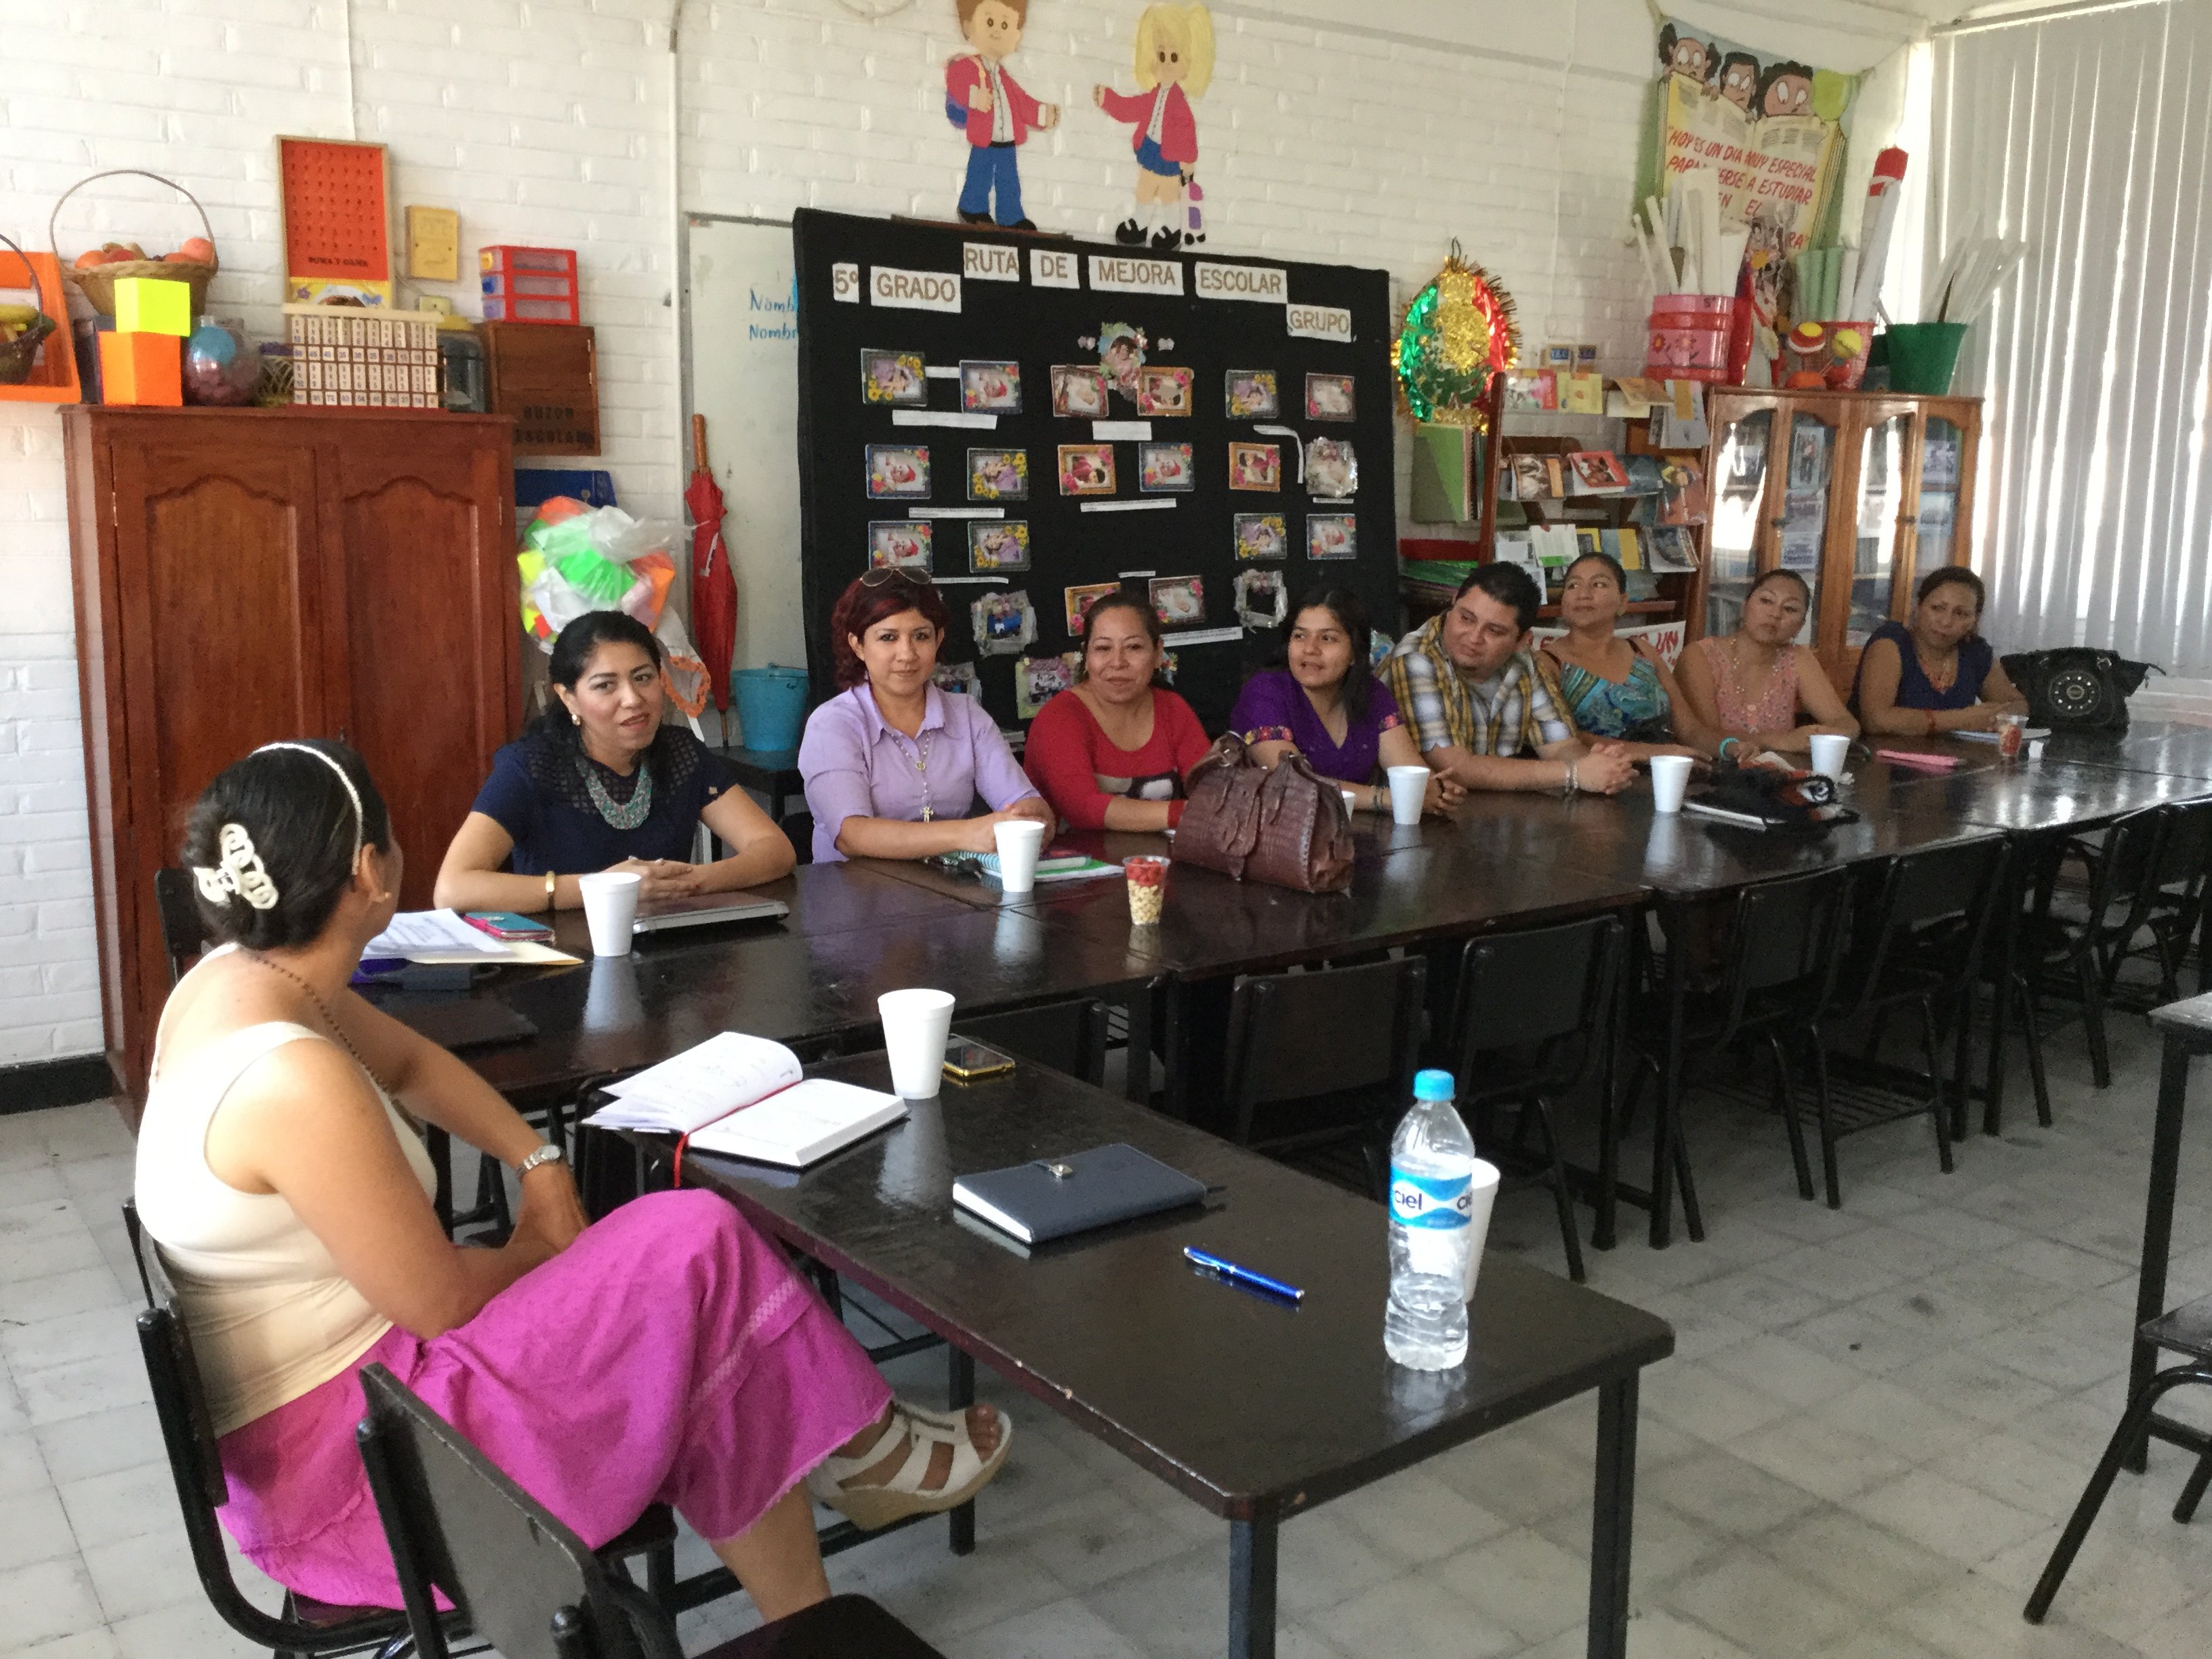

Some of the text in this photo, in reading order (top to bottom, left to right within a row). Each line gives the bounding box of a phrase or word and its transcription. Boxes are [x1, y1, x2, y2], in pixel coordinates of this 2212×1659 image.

[1694, 137, 1706, 153] ES
[1704, 142, 1723, 159] UN
[1723, 145, 1744, 163] DIA
[1744, 150, 1769, 169] MUY
[1767, 158, 1818, 182] ESPECIAL
[1746, 176, 1757, 192] A
[1757, 178, 1814, 206] ESTUDIAR
[965, 248, 1282, 295] RUTA DE MEJORA ESCOLAR
[877, 272, 956, 303] GRADO
[1290, 310, 1350, 335] GRUPO
